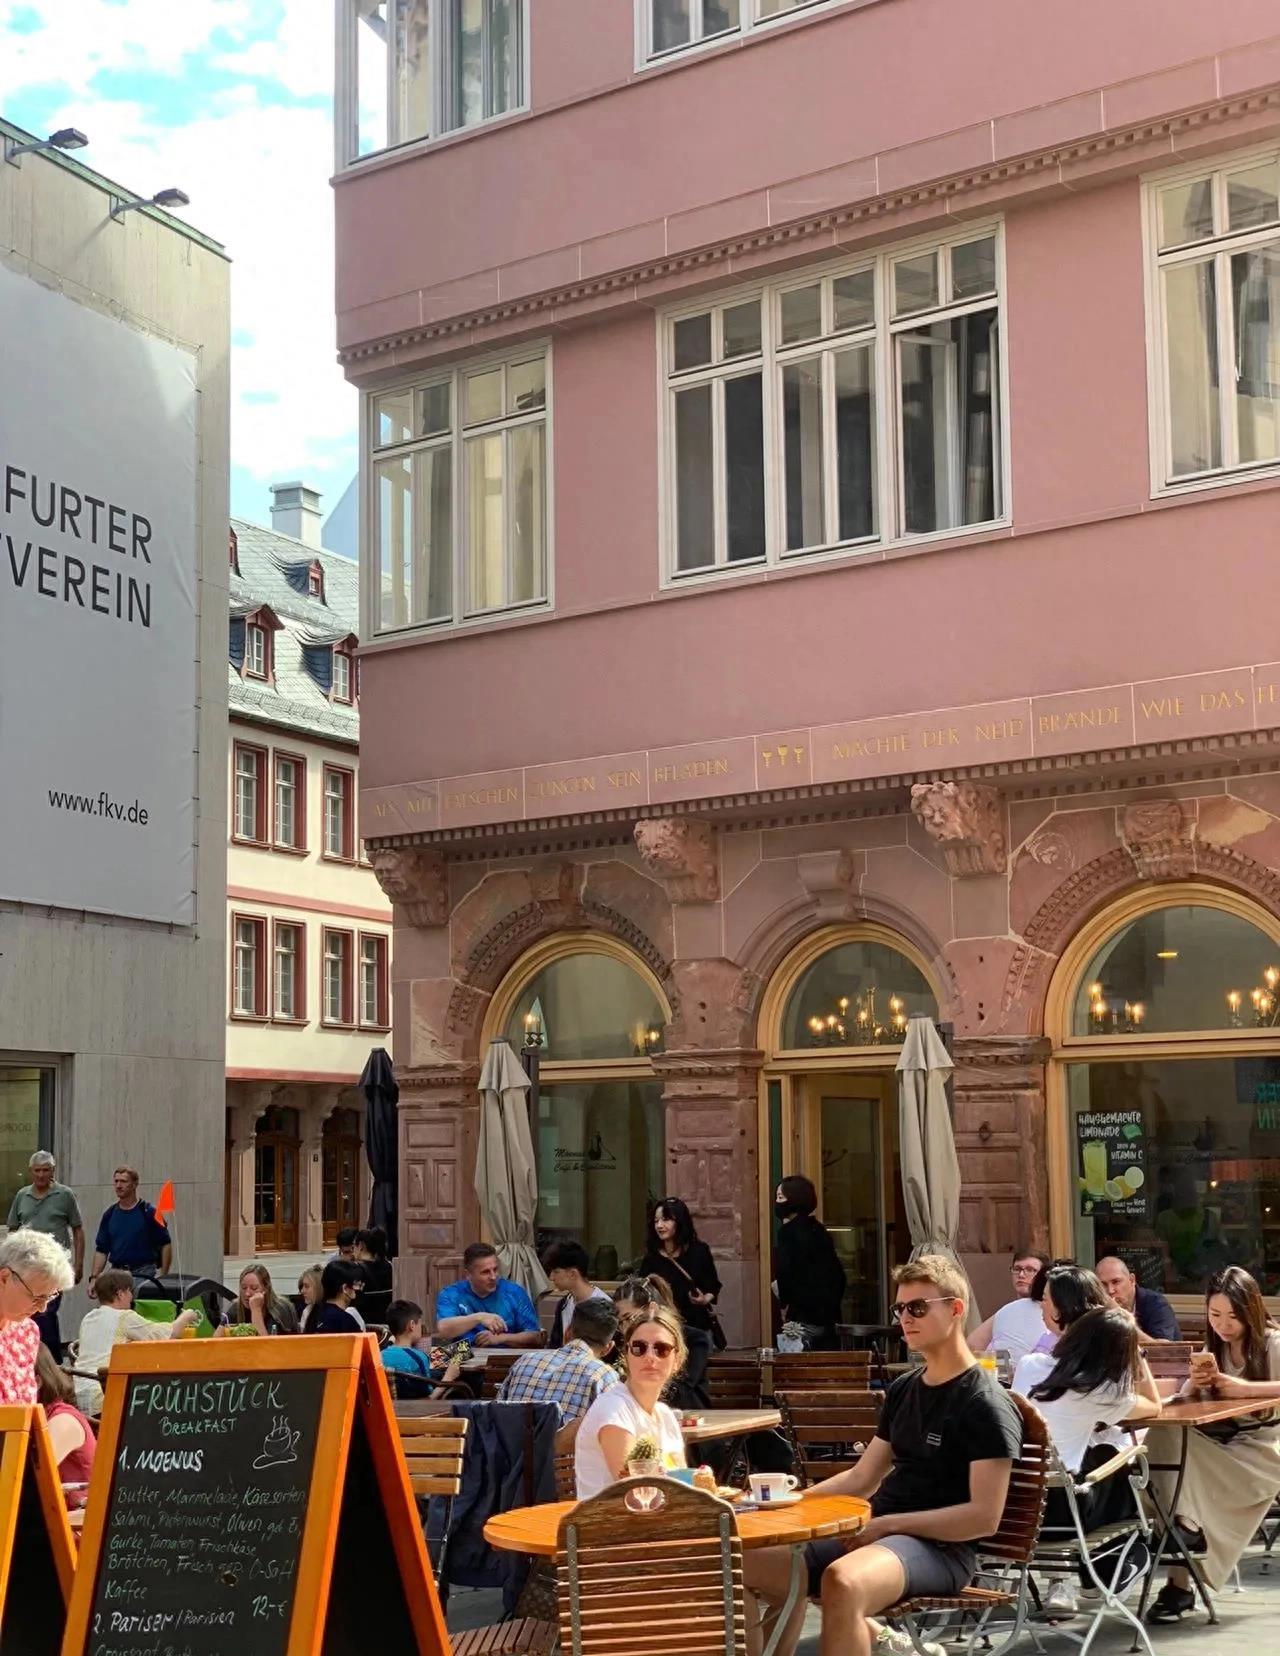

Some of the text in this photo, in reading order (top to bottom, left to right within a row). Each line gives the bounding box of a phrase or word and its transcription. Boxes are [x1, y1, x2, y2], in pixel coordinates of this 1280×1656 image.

[6, 465, 151, 563] FURTER
[0, 533, 150, 627] VEREIN
[1140, 697, 1184, 720] WIE
[1199, 688, 1246, 713] DAS
[49, 790, 149, 825] www.fkv.de
[129, 1379, 284, 1416] FRÜHSTÜCK
[118, 1446, 204, 1472] 1. MOENUS
[104, 1579, 148, 1604] Kaffee
